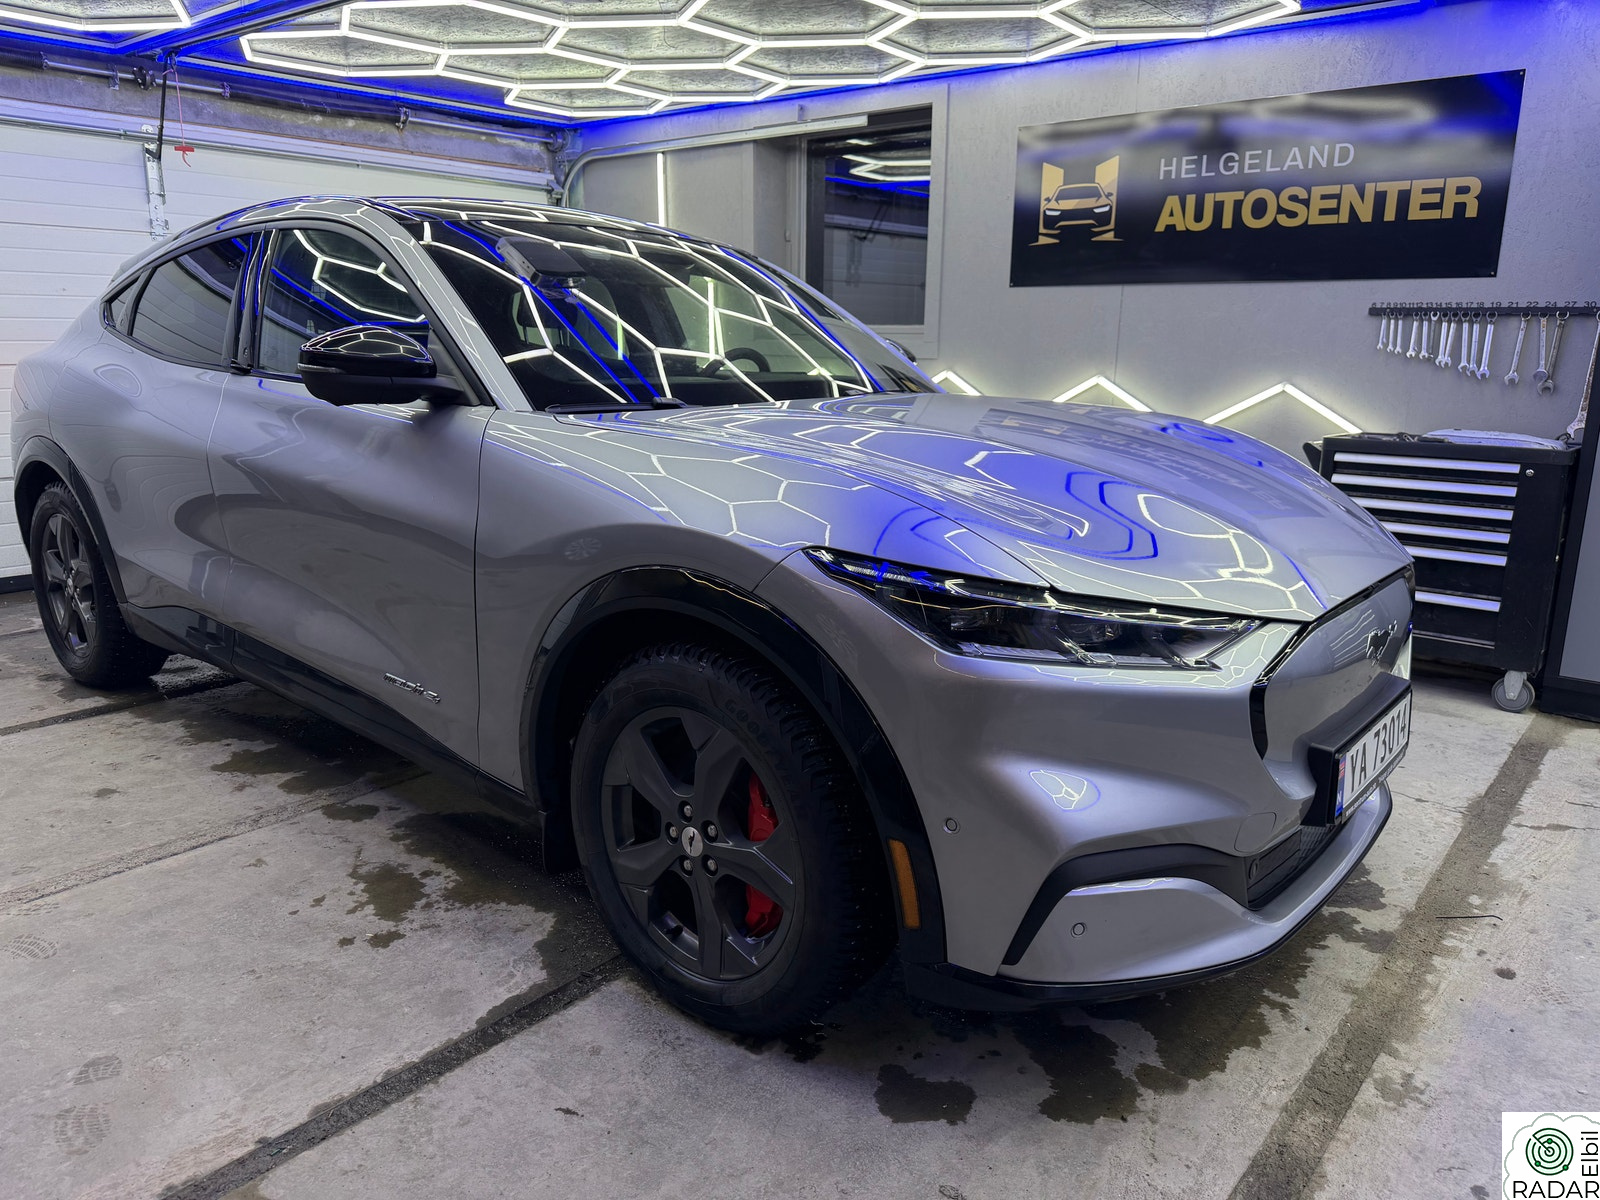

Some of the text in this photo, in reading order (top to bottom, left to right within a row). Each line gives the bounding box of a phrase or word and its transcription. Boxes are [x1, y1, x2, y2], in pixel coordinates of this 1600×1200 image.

[1158, 142, 1355, 180] HELGELAND
[1154, 176, 1482, 233] AUTOSENTER
[1350, 741, 1367, 794] YA
[1373, 703, 1407, 772] 73014
[1336, 791, 1342, 806] N
